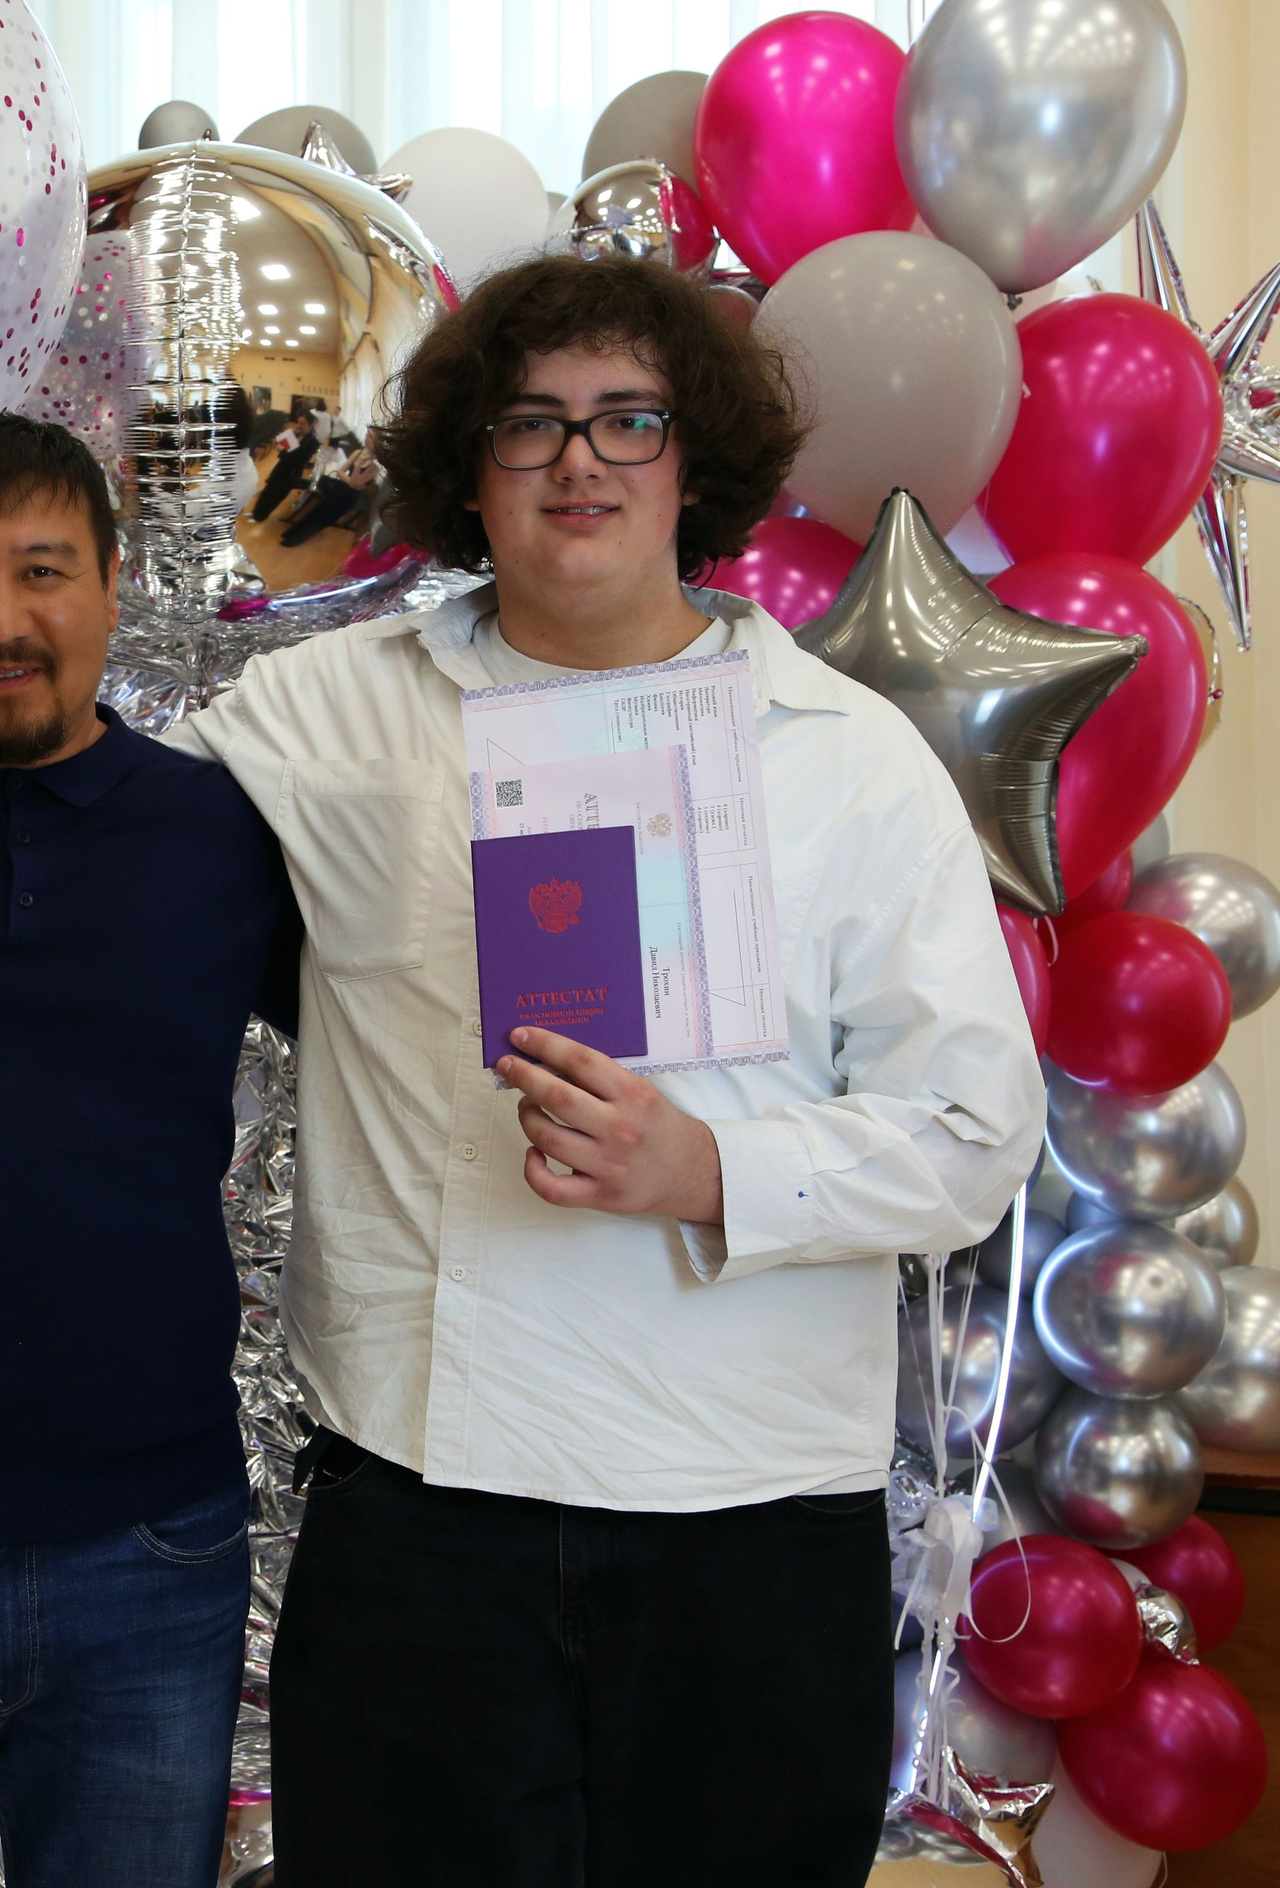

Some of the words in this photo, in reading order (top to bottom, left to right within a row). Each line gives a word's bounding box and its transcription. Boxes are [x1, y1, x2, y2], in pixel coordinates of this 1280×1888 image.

[584, 793, 600, 829] АТТЕ
[649, 946, 658, 971] Давид
[652, 972, 661, 1019] Николаевич
[661, 967, 670, 996] Трохин
[516, 987, 608, 1007] АТТЕСТАТ
